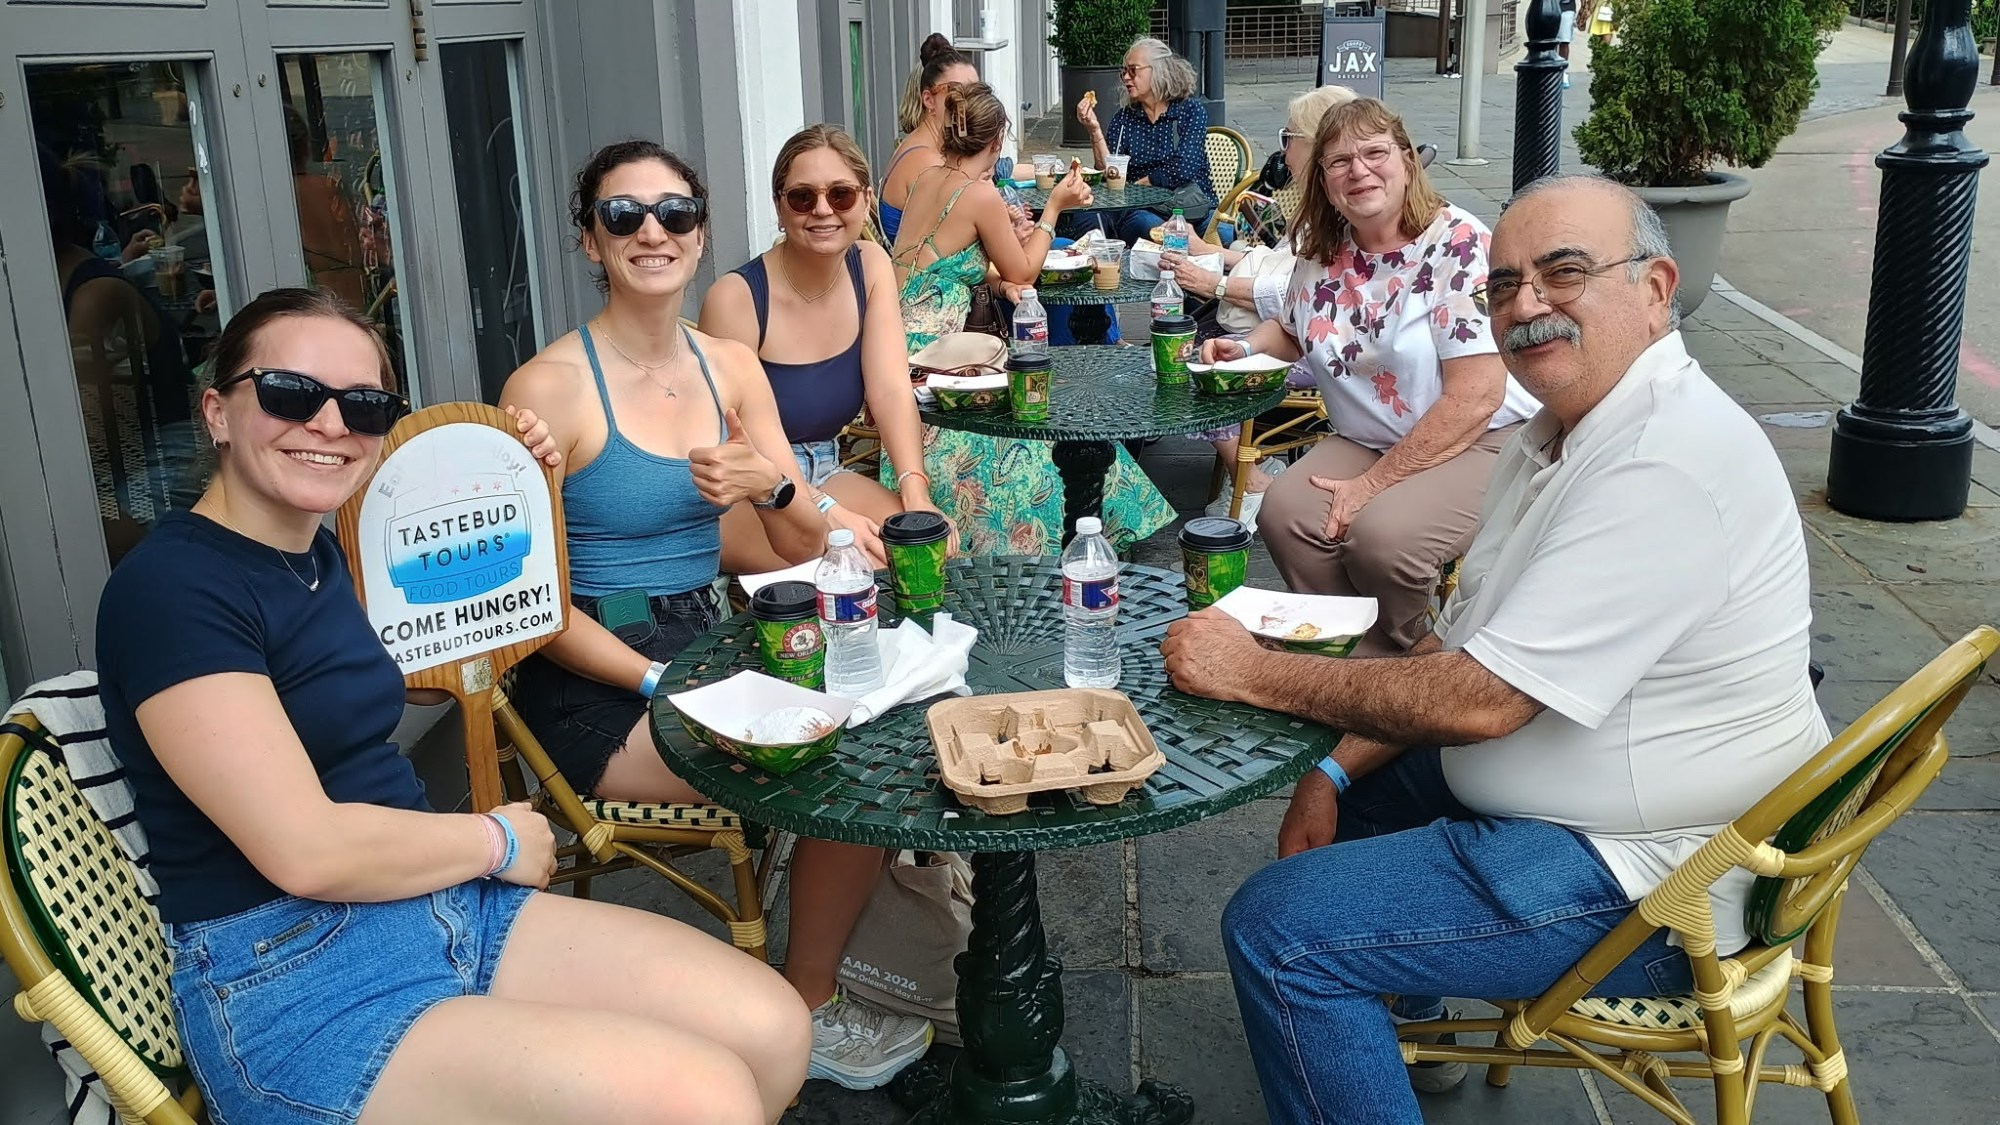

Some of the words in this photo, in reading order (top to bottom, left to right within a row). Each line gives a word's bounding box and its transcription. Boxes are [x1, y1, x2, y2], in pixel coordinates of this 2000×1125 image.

[398, 504, 517, 547] TASTEBUD
[408, 580, 458, 600] FOOD
[466, 562, 520, 590] TOURS
[380, 611, 447, 646] COME
[455, 583, 551, 627] HUNGRY!
[394, 611, 553, 665] ASTEBUDTOURS.COM
[840, 967, 856, 979] New
[859, 974, 887, 990] Orleans
[894, 988, 911, 999] May
[843, 956, 880, 977] AAPA
[883, 972, 918, 991] 2026
